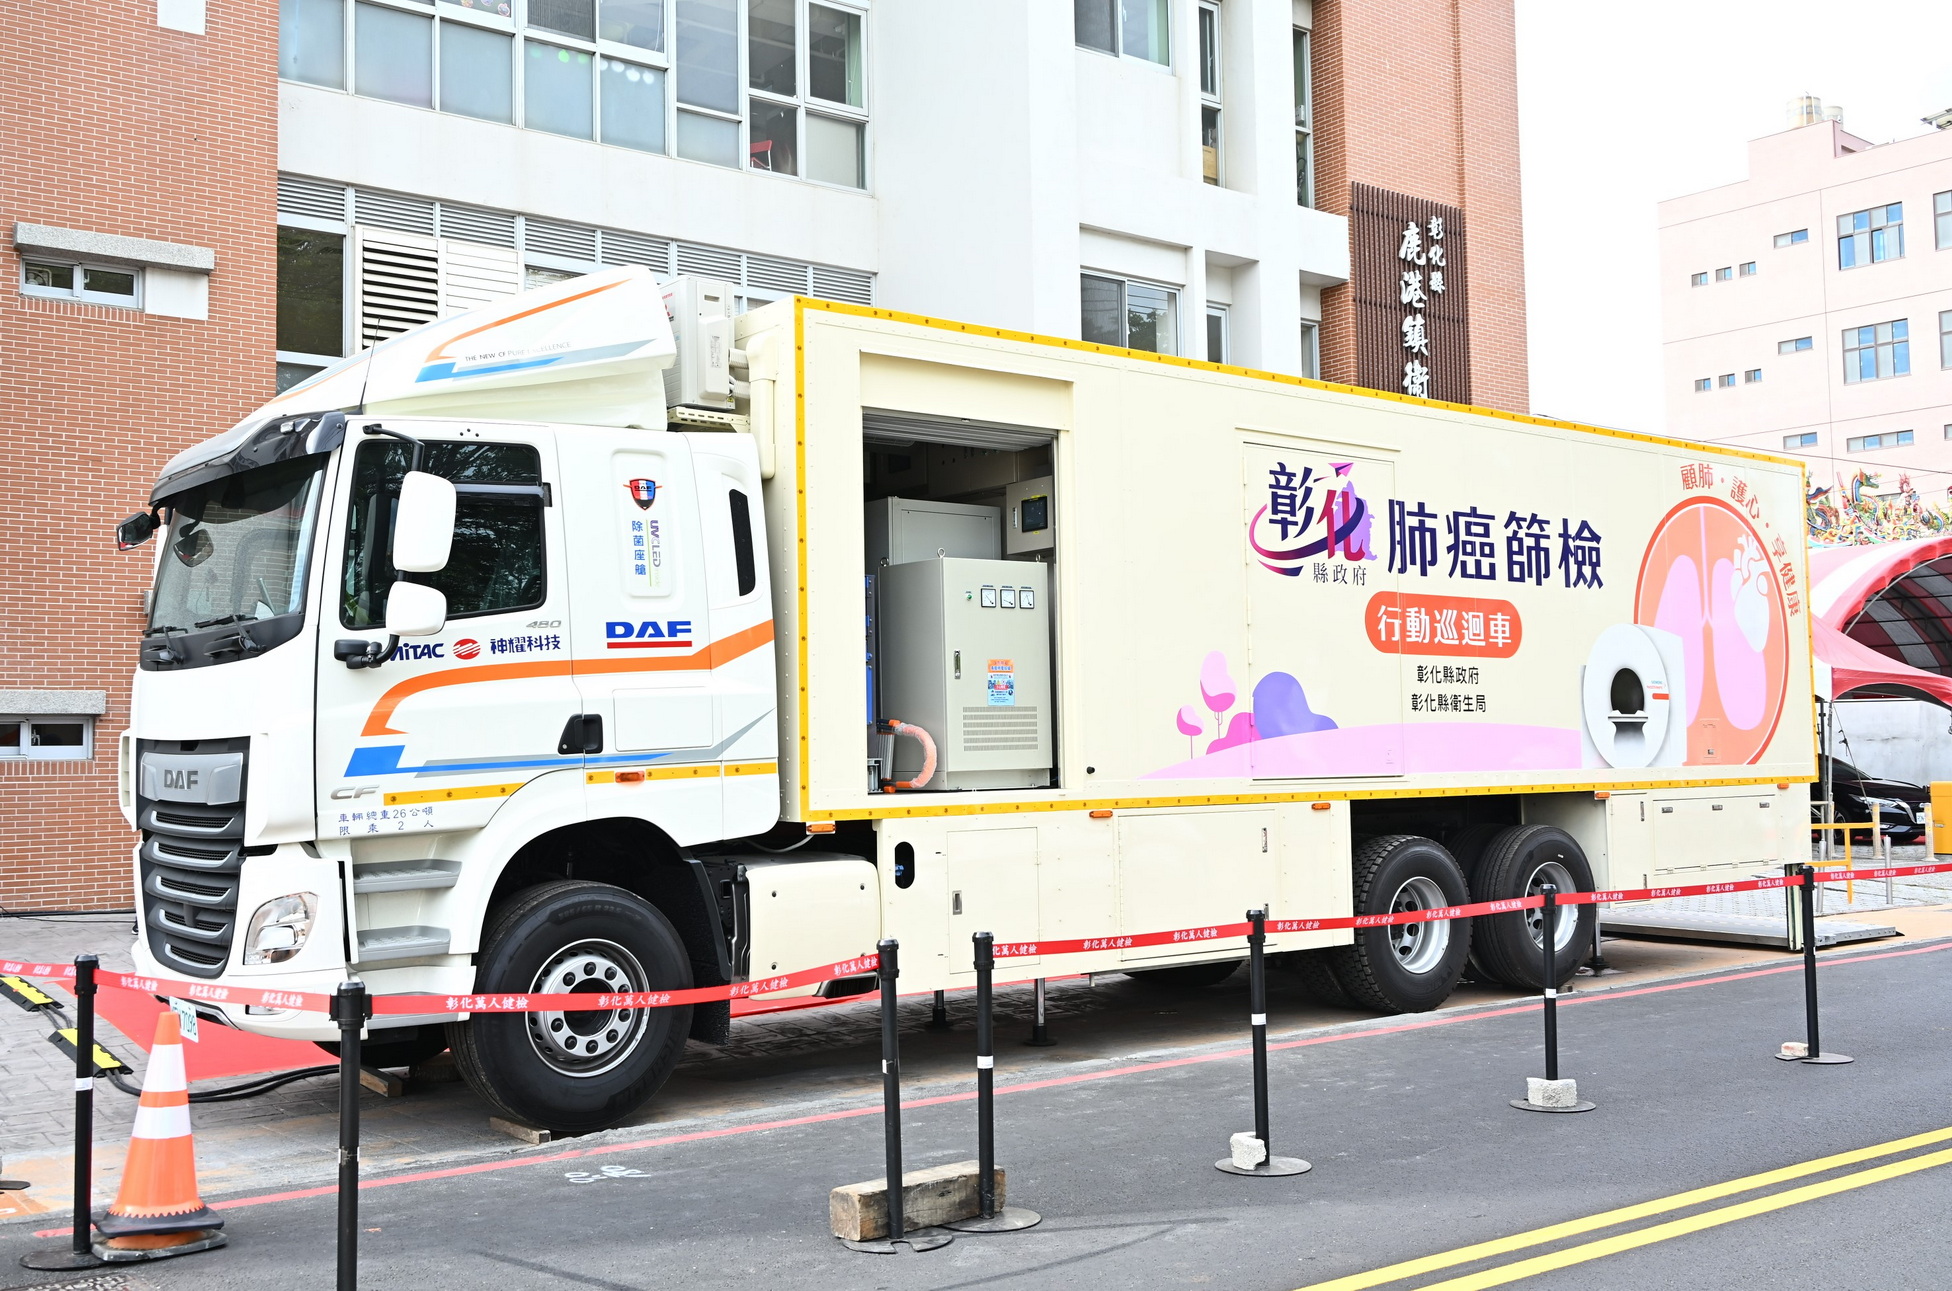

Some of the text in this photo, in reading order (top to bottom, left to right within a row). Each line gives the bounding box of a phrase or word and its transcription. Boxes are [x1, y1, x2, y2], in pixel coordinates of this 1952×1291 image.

[1427, 215, 1446, 294] 彰化縣
[465, 354, 477, 362] THE
[479, 352, 496, 360] NEW
[631, 520, 646, 576] 除菌座艙
[1387, 498, 1604, 590] 肺癌篩檢
[1312, 562, 1367, 586] 縣政府
[606, 621, 692, 638] DAF
[1377, 604, 1512, 648] 行動巡迴車
[490, 634, 561, 654] 神耀科技
[1416, 665, 1479, 685] 彰化縣政府
[1411, 693, 1487, 713] 彰化縣衛生局
[164, 769, 198, 790] DAF
[330, 784, 380, 800] CF
[1083, 937, 1133, 950] 彰化萬人健檢
[1173, 928, 1218, 942] 彰化萬人健檢
[729, 977, 789, 997] 彰化萬人健檢
[445, 996, 529, 1010] 彰化萬人健檢
[598, 993, 671, 1008] 彰化萬人健檢
